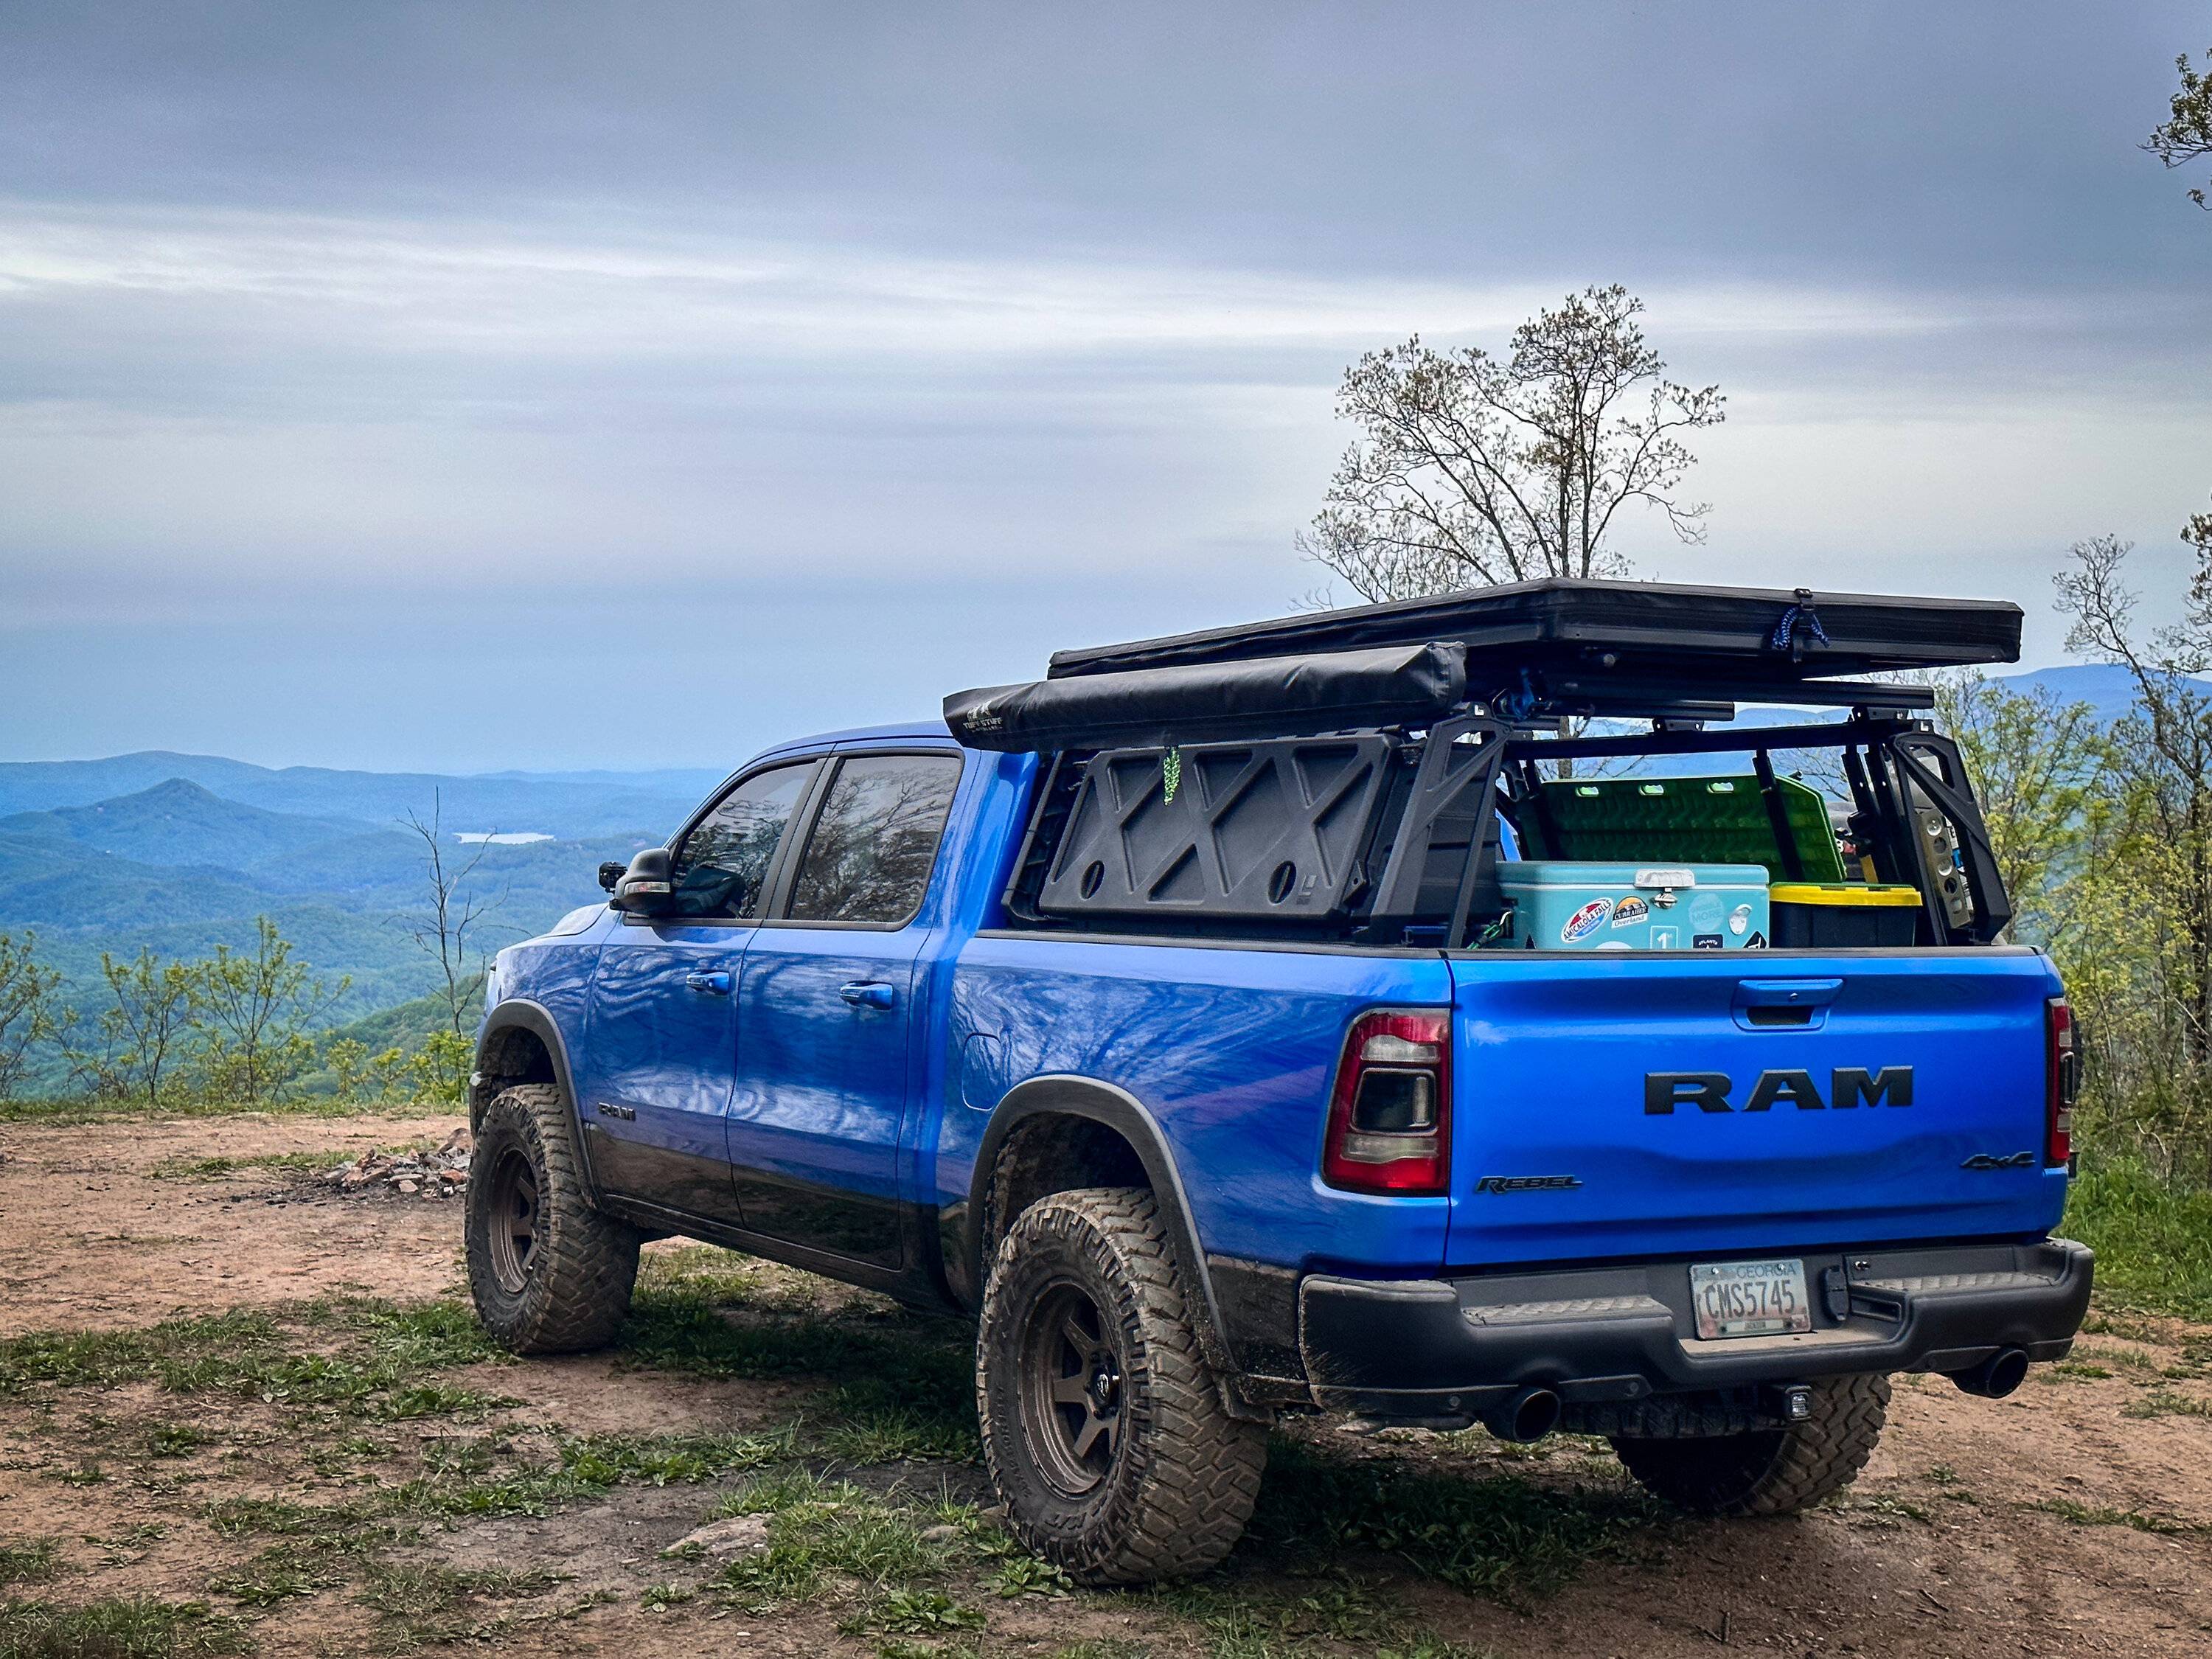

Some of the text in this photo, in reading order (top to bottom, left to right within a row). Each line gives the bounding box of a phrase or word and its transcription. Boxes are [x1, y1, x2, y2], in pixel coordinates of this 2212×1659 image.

[1564, 900, 1612, 941] AMICALOLA FALLS
[1614, 915, 1645, 927] Overland
[1691, 910, 1722, 922] MORE
[1644, 1065, 1914, 1115] RAM
[597, 1102, 636, 1121] RAM
[1475, 1175, 1583, 1194] REBEL
[1736, 1262, 1796, 1279] GEORGIA
[1703, 1279, 1795, 1319] CMS5745
